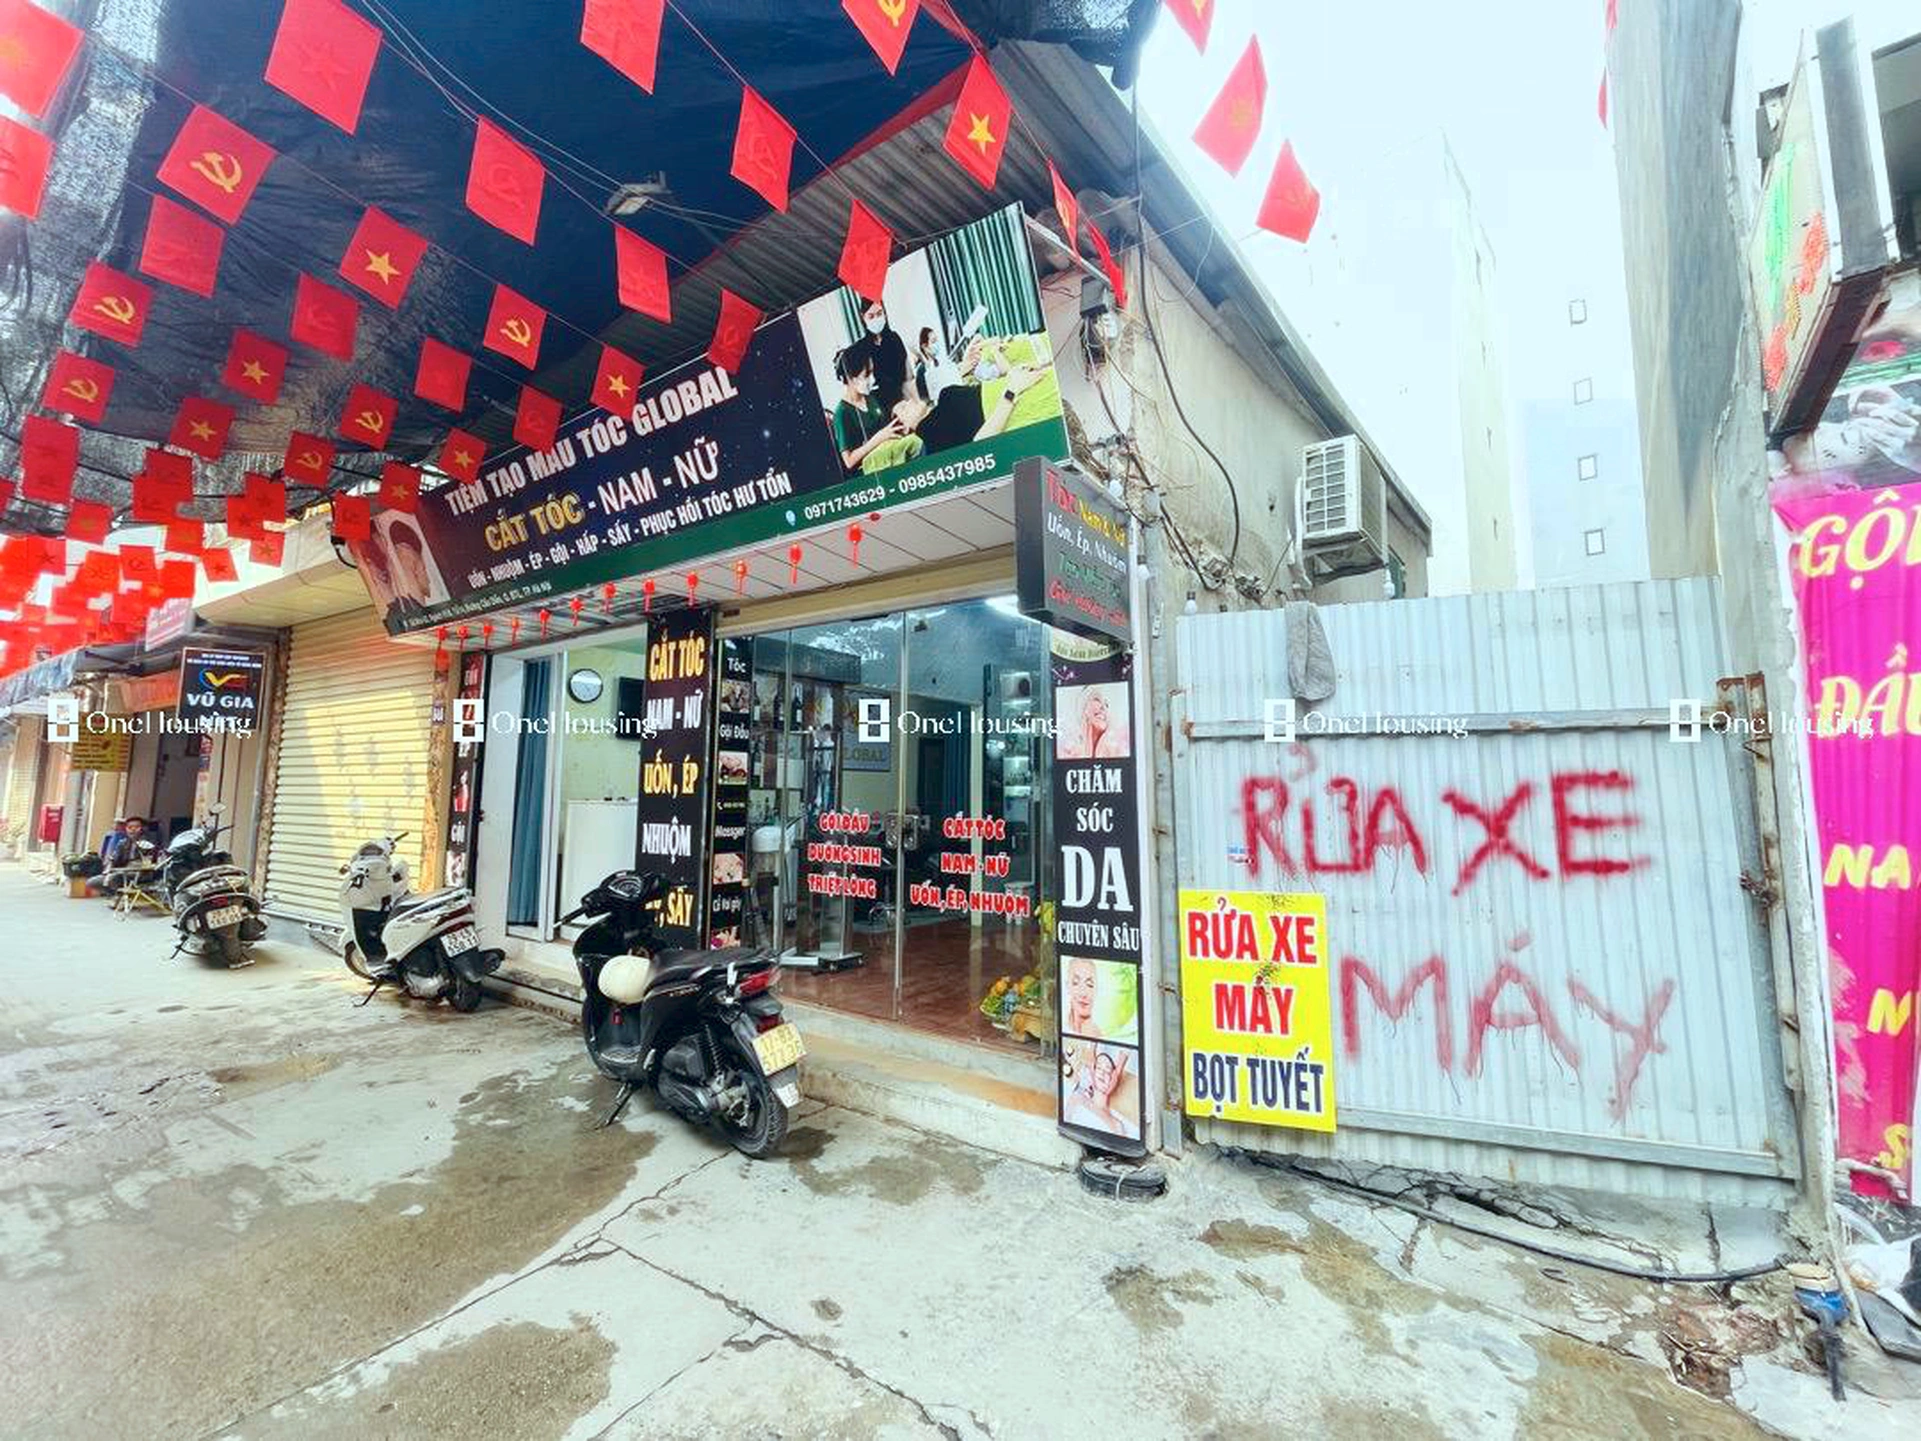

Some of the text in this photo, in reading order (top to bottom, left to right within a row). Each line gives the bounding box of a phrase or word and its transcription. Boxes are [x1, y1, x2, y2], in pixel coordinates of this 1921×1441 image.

[486, 462, 527, 498] TẠO
[576, 418, 628, 458] TÓC
[632, 365, 739, 437] GLOBAL
[485, 509, 530, 551] CẮT
[529, 491, 588, 537] TÓC
[597, 467, 658, 514] NAM
[673, 436, 720, 489] NỮ
[528, 551, 543, 571] ÉP
[550, 541, 570, 565] GỘI
[575, 530, 599, 557] HẤP
[606, 520, 633, 546] SẤY
[640, 508, 677, 536] PHỤC
[702, 489, 733, 517] TÓC
[732, 480, 758, 509] HƯ
[755, 468, 794, 504] TỔN
[804, 486, 886, 521] 0971743629
[899, 452, 997, 494] 0985437985
[650, 628, 705, 682] CẮT TÓC
[186, 691, 255, 709] VŨ GIA
[682, 753, 700, 795] ÉP
[1065, 763, 1123, 794] CHĂM
[641, 816, 692, 864] NHUỘM
[1076, 802, 1114, 833] SÓC
[1441, 770, 1655, 897] XE
[1061, 845, 1135, 913] DA
[1058, 919, 1141, 951] CHUYÊN SÂU
[1187, 897, 1318, 965] RỬA XE
[1339, 929, 1675, 1120] MÁY
[1193, 1047, 1324, 1114] BỌT TUYẾT
